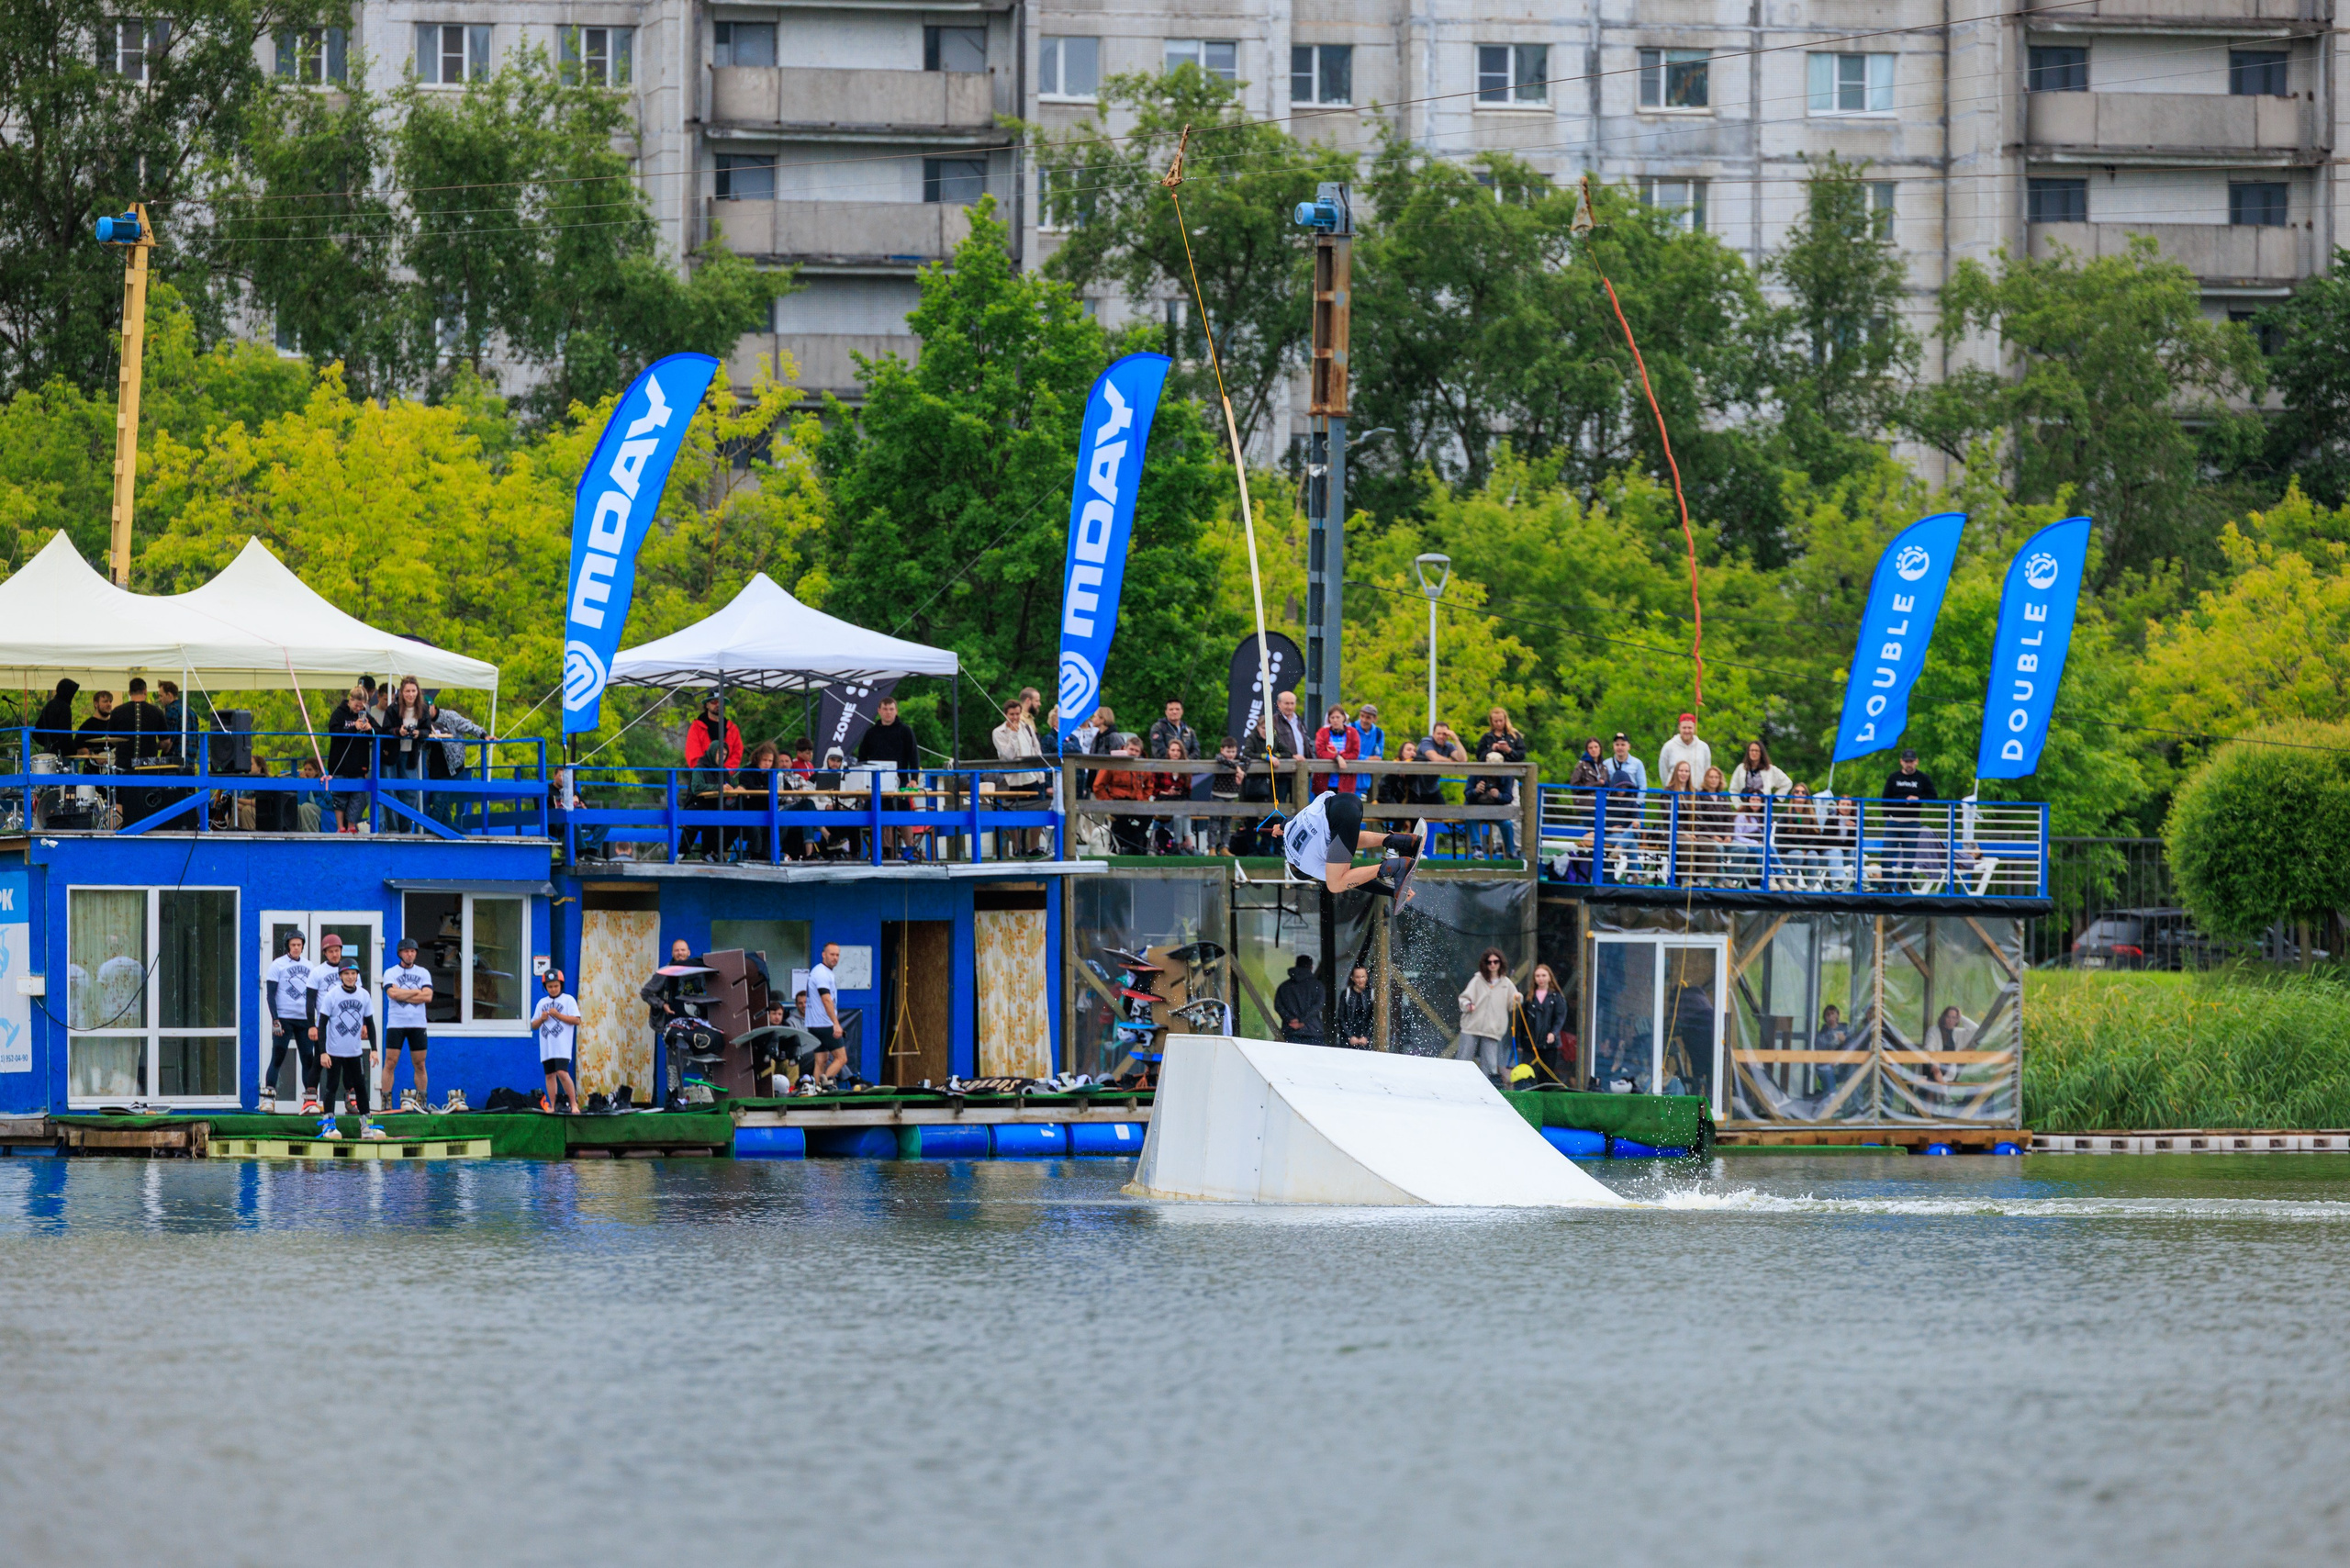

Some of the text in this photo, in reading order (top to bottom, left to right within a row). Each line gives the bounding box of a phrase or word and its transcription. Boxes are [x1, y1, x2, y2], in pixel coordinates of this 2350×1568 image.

[832, 701, 857, 743] ZONE
[1855, 593, 1916, 743] DOUBLE
[2000, 602, 2048, 761] DOUBLE
